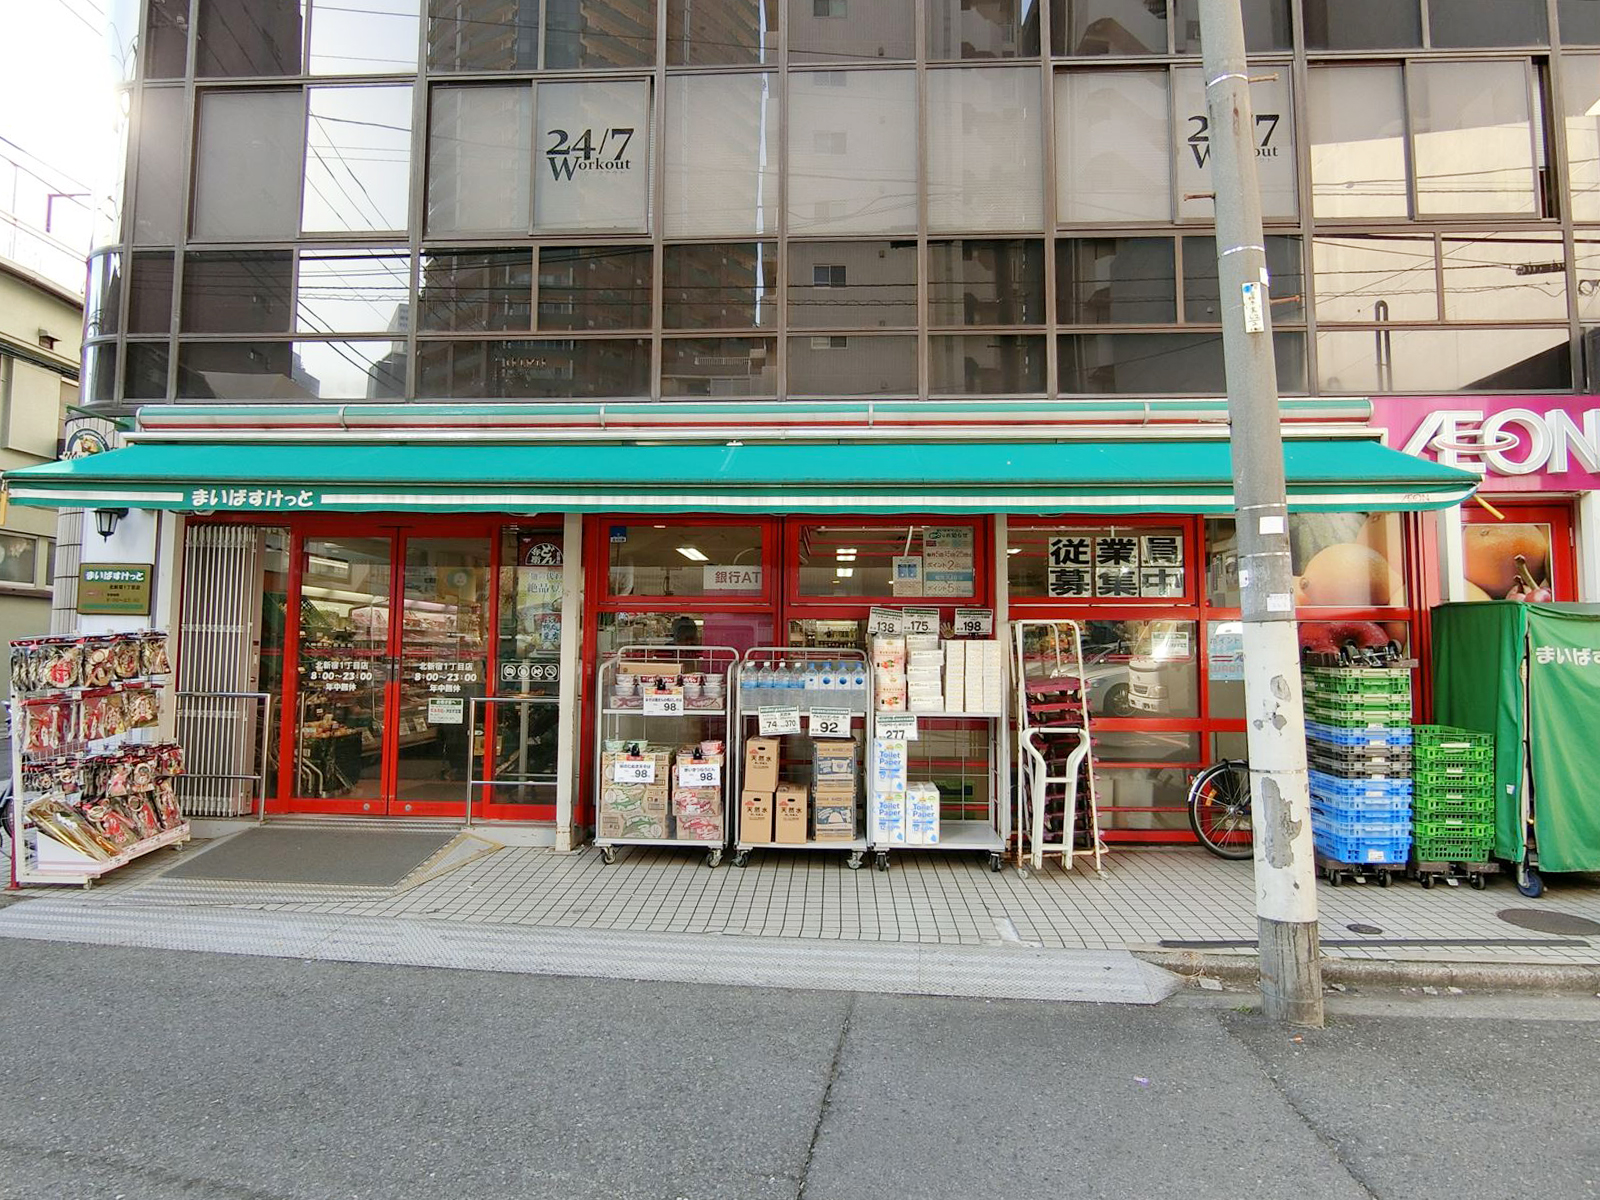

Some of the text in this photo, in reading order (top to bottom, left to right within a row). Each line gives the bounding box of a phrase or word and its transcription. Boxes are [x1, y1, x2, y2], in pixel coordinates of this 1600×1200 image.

[1187, 114, 1280, 147] 27
[546, 128, 634, 160] 24/7
[1189, 144, 1279, 169] Wout
[547, 156, 631, 181] Workout
[191, 488, 314, 507] まいばすけっと
[1050, 537, 1179, 565] 従業員
[85, 570, 145, 581] まいばすけっと
[1050, 568, 1183, 597] 募集中
[877, 621, 895, 632] 138
[910, 621, 929, 631] 175
[963, 621, 982, 631] 198
[315, 661, 369, 670] 北新宿1丁目店
[419, 662, 473, 671] 北新宿1丁目店
[325, 682, 357, 692] 年中無休
[429, 684, 462, 693] 年中無休
[663, 702, 677, 711] 98
[766, 720, 777, 728] 74
[819, 721, 839, 733] 92
[885, 729, 905, 739] 277
[879, 758, 902, 766] Paper
[634, 769, 648, 778] 98
[700, 772, 713, 782] 98
